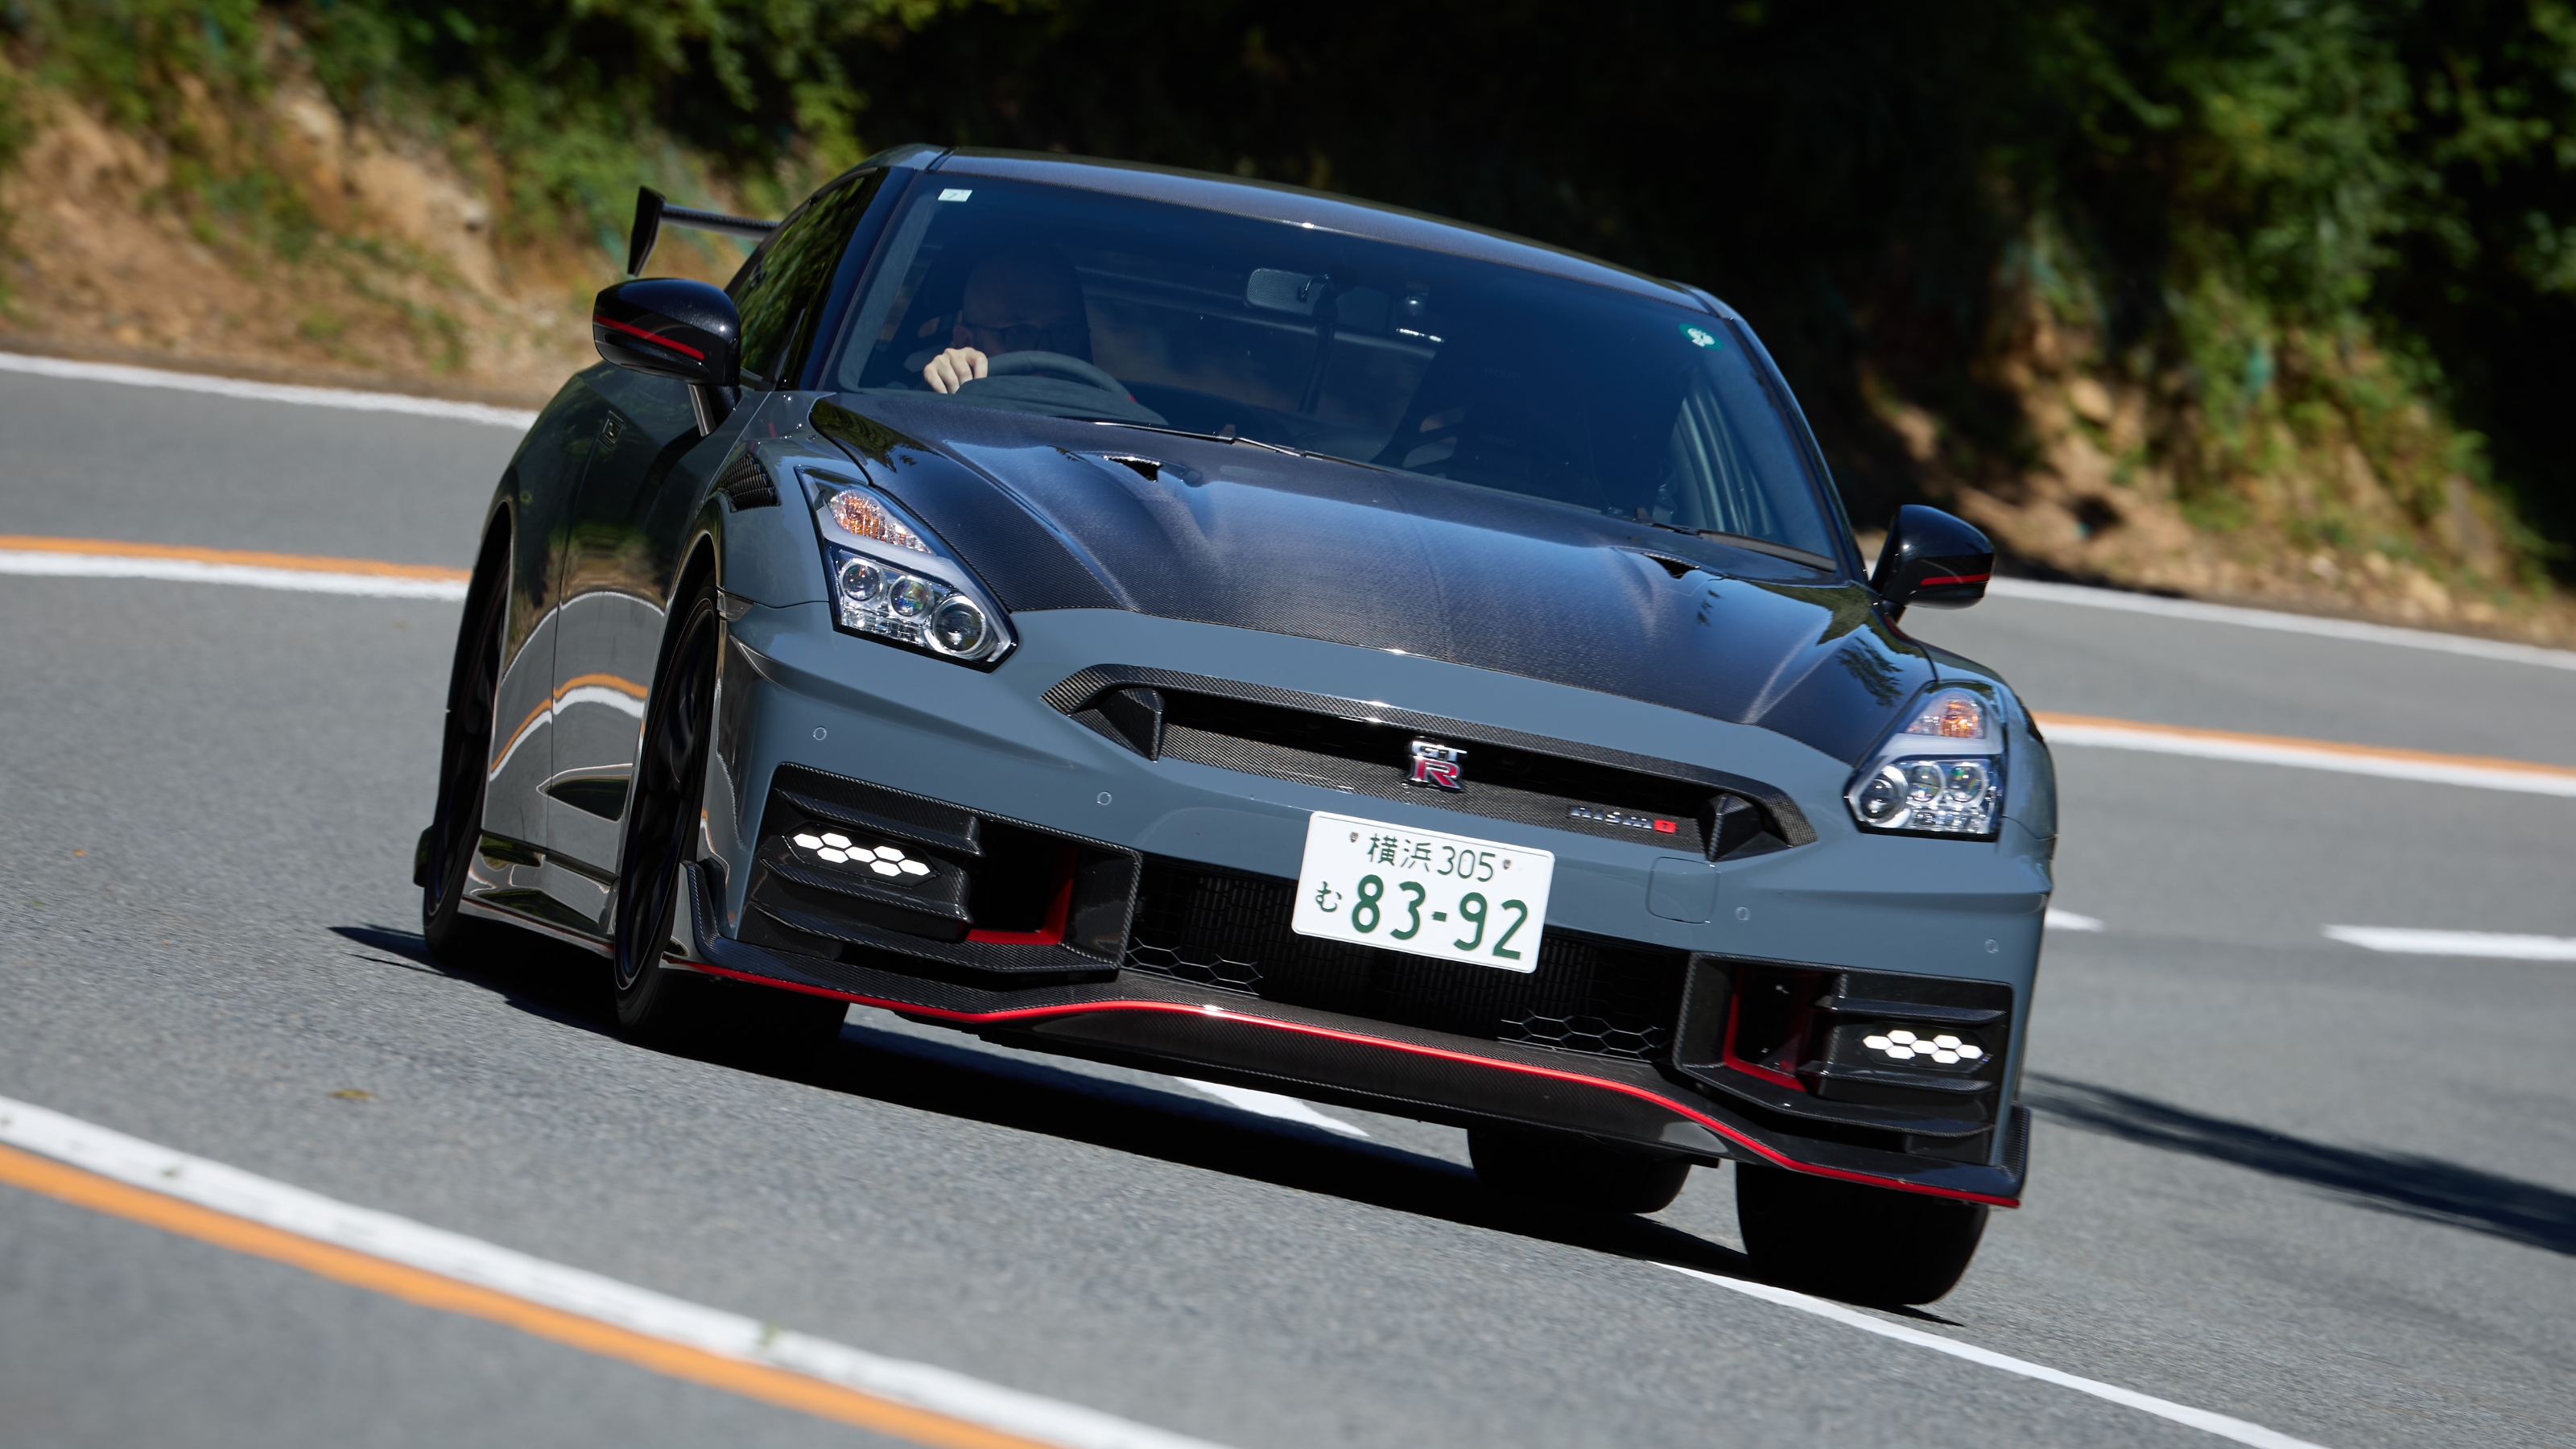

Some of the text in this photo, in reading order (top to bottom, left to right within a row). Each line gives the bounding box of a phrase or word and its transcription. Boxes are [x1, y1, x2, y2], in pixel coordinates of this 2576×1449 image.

[1410, 740, 1468, 762] GT
[1410, 755, 1462, 790] R
[1367, 832, 1496, 882] 横浜 305
[1315, 873, 1528, 960] む 83-92
